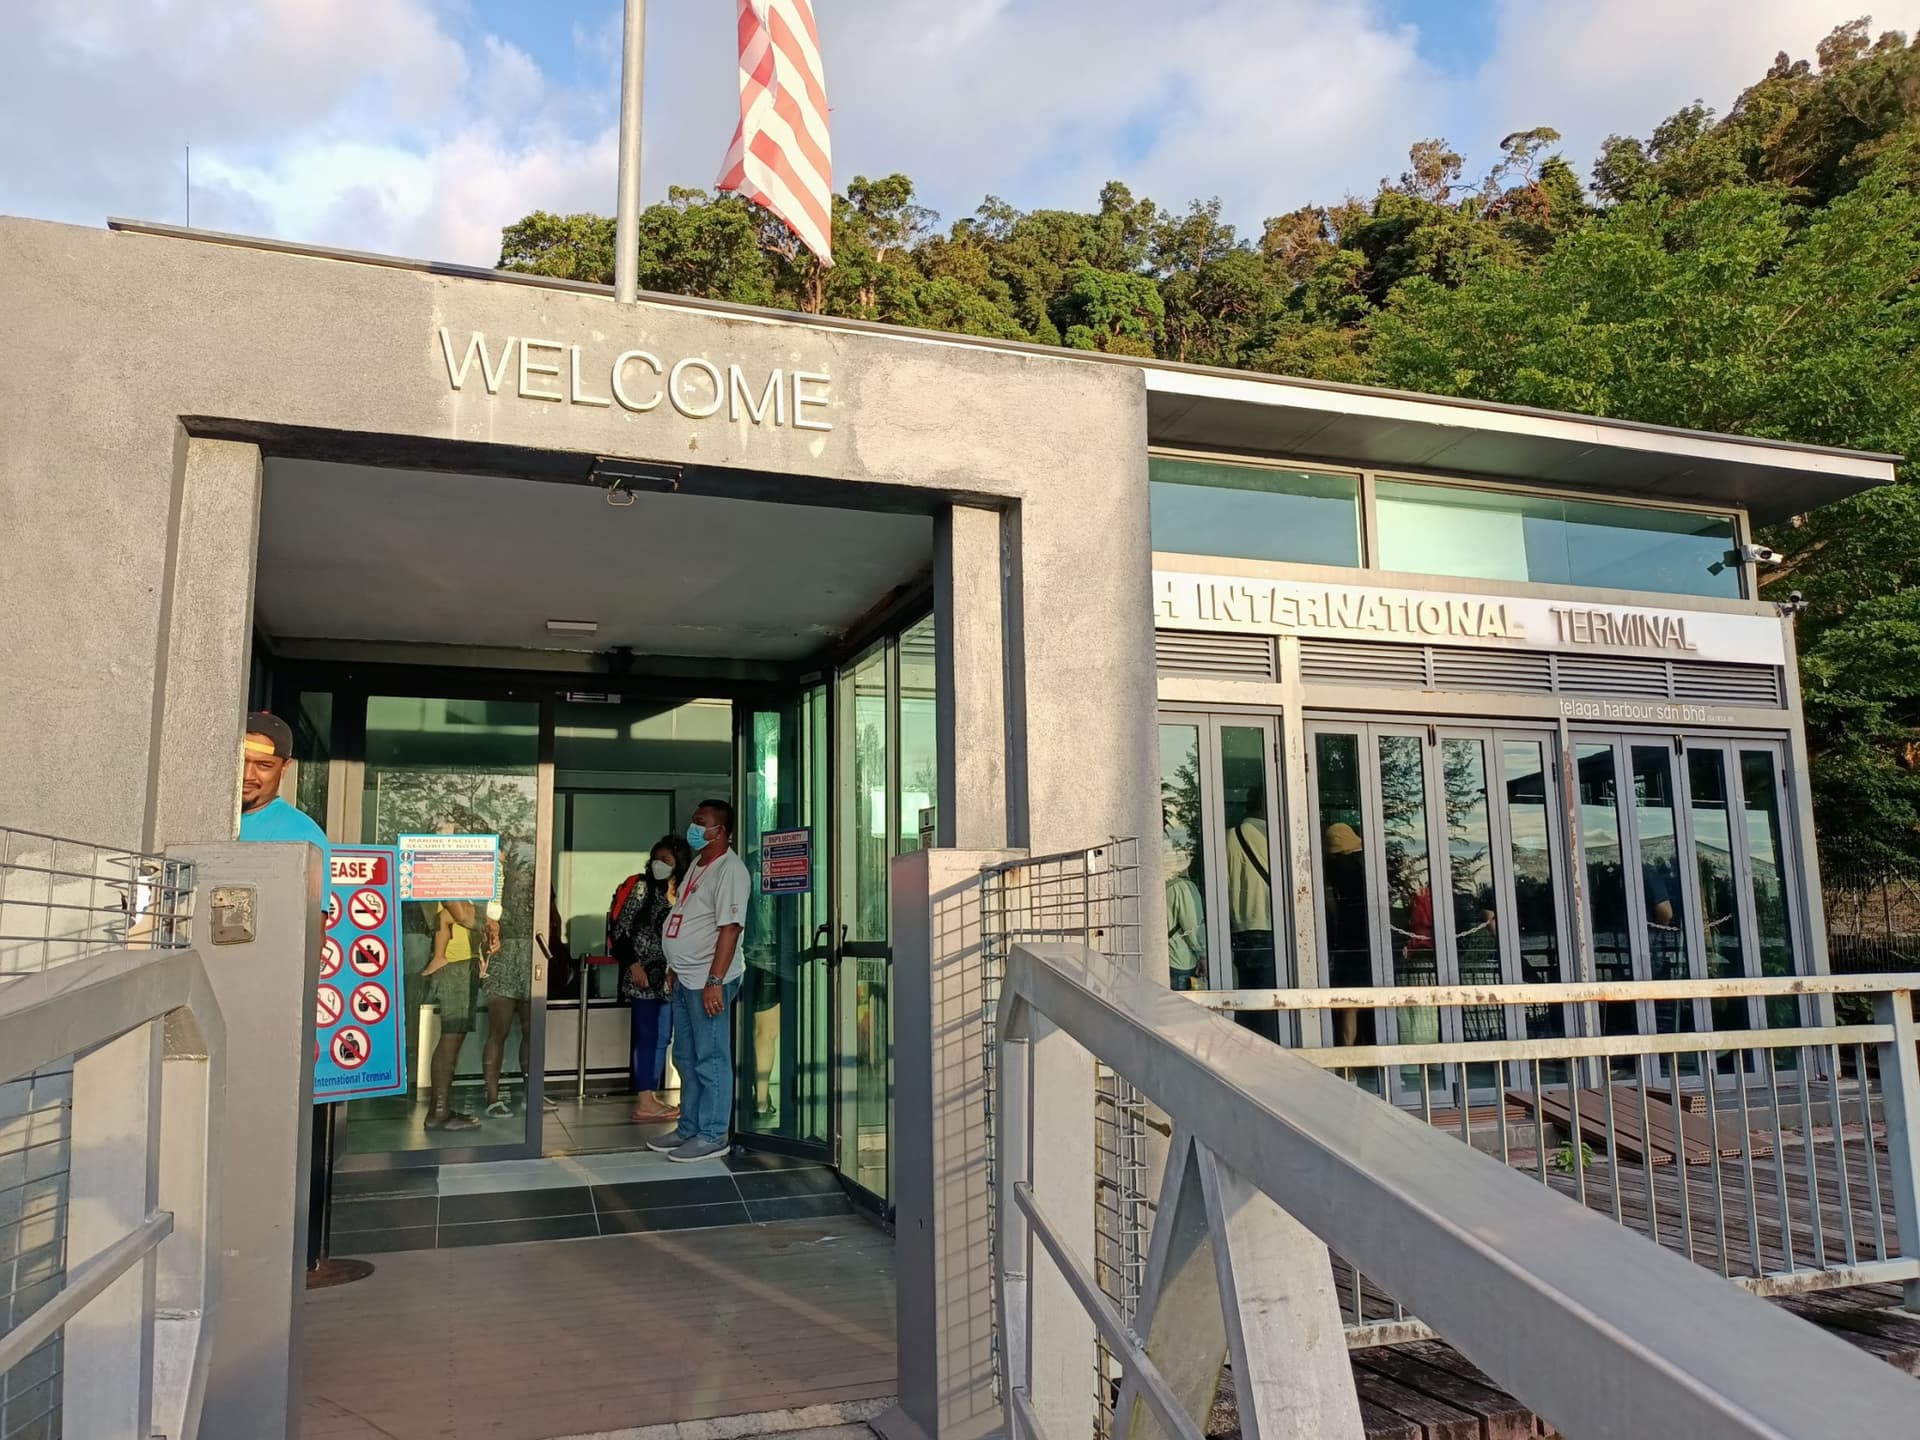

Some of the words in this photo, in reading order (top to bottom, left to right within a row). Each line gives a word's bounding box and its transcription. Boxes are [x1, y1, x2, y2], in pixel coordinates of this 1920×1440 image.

[440, 327, 833, 431] WELCOME
[1197, 582, 1526, 639] INTERNATIONAL
[1549, 606, 1697, 651] TERMINAL
[1559, 698, 1600, 719] telaga
[1603, 700, 1653, 719] harbour
[1656, 702, 1680, 720] sdn
[1683, 704, 1706, 721] bhd
[781, 833, 802, 841] SECURITY
[314, 1071, 360, 1088] International
[361, 1069, 392, 1083] Terminal
